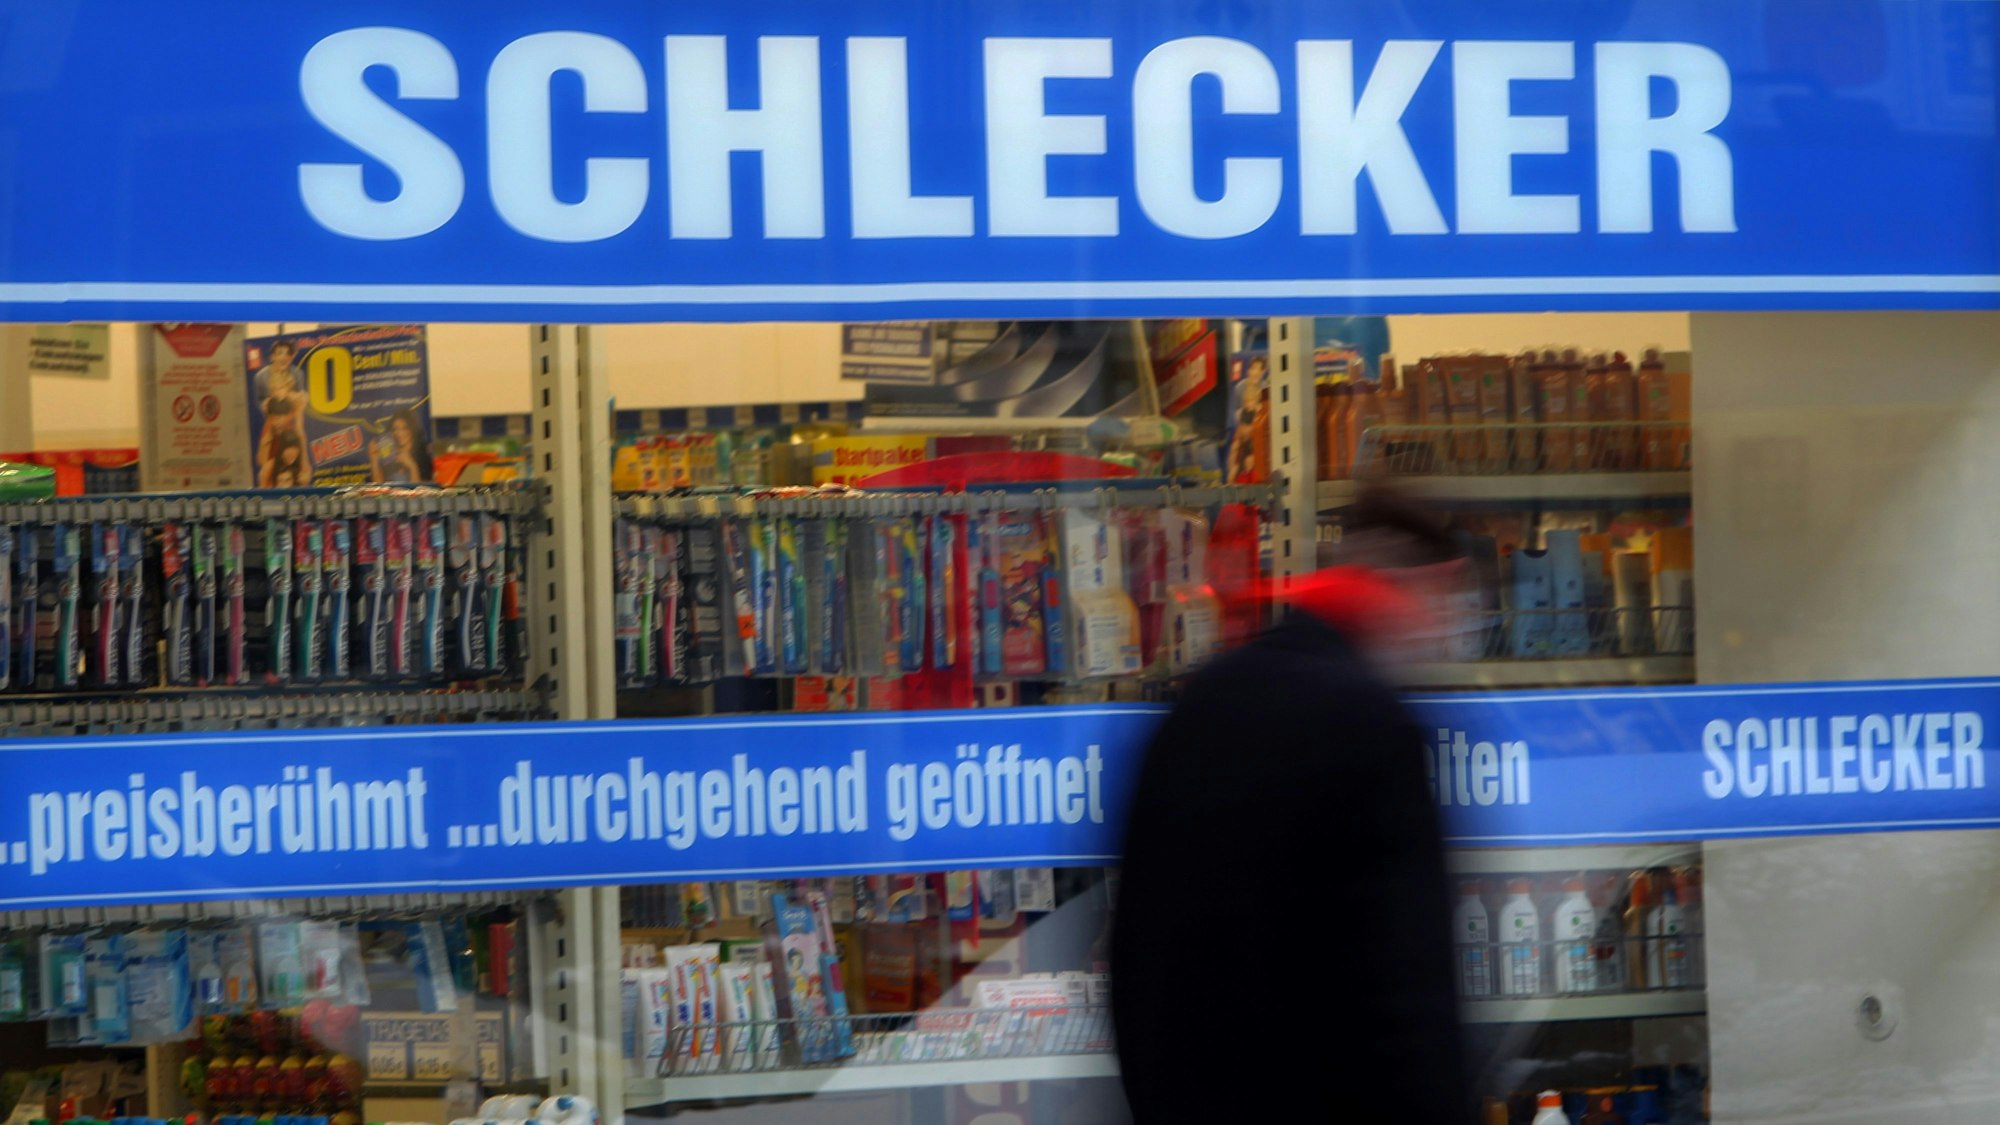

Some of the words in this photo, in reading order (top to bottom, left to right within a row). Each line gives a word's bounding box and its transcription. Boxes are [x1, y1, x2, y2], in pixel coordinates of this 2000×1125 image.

[297, 26, 1738, 242] SCHLECKER
[310, 426, 364, 464] NEU
[835, 444, 927, 467] Startpake
[446, 749, 869, 850] ...durchgehend
[886, 743, 1104, 841] geöffnet
[1702, 711, 1986, 800] SCHLECKER
